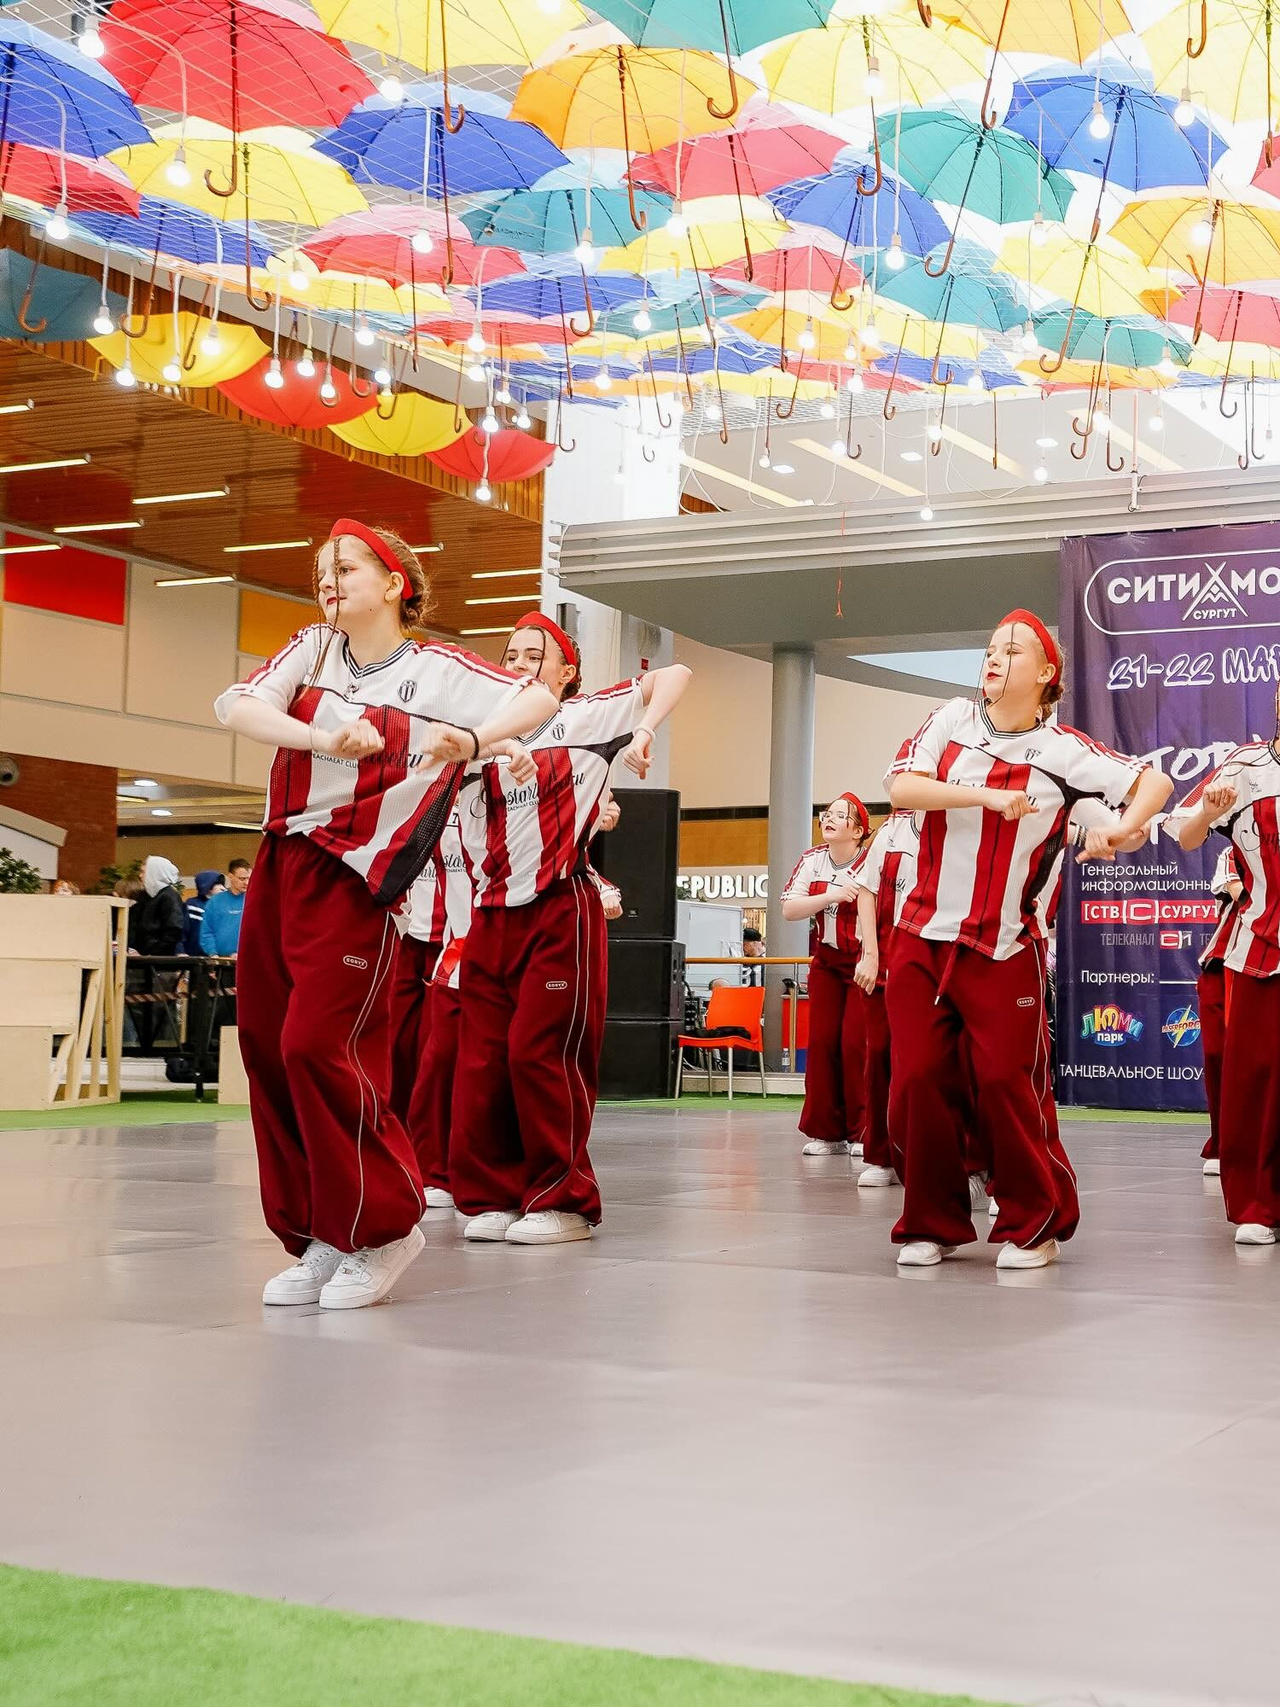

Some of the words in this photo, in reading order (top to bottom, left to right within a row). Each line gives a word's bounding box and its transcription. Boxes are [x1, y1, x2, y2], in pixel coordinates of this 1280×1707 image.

[1193, 607, 1237, 620] СУРГУТ
[1107, 654, 1215, 690] 21-22
[1082, 862, 1178, 877] Генеральный
[1101, 933, 1155, 946] ТЕЛЕКАНАЛ
[1082, 970, 1155, 985] Партнеры:
[1097, 1033, 1124, 1043] парк
[1060, 1064, 1164, 1080] ТАНЦЕВАЛЬНОЕ
[1167, 1067, 1204, 1081] ШОУ
